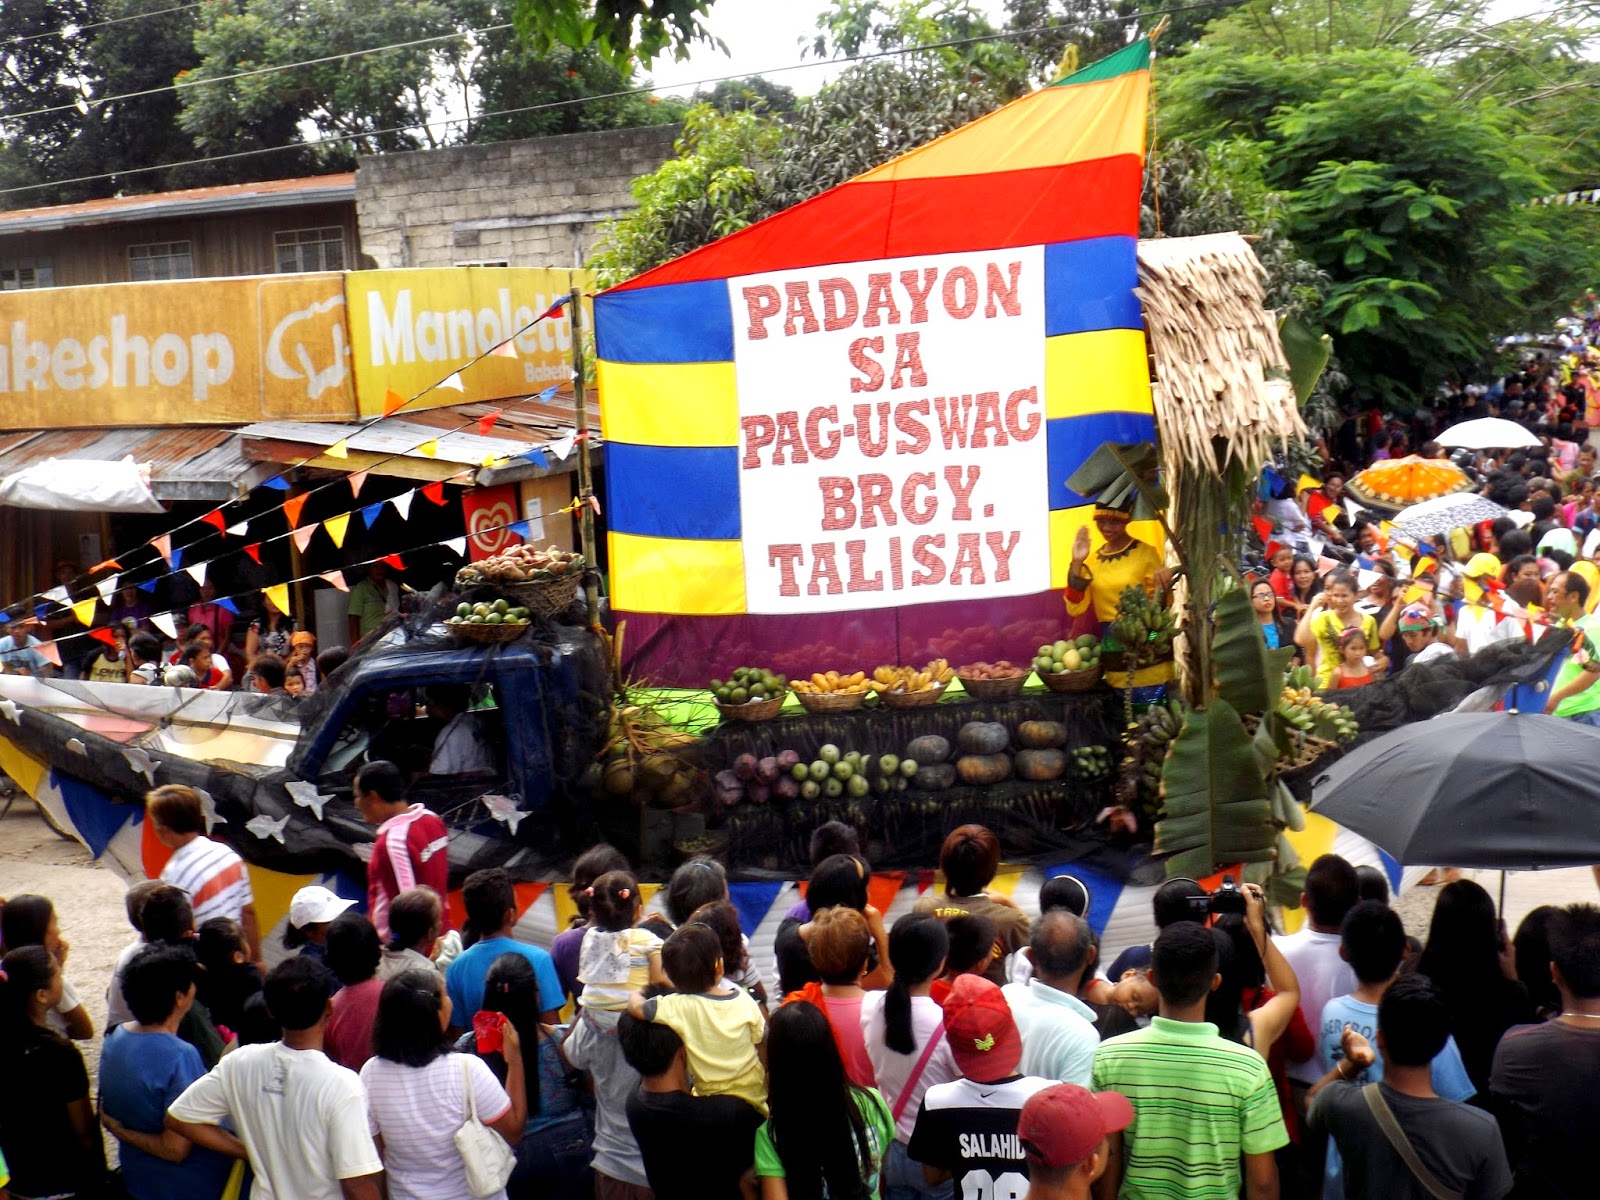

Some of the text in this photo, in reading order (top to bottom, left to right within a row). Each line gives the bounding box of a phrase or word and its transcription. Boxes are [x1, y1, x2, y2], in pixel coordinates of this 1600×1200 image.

[366, 287, 590, 367] Manolett
[742, 261, 1022, 340] PADAYON
[0, 313, 235, 401] keshop
[848, 331, 928, 393] SA
[741, 386, 1042, 470] PAG-USWAG
[818, 465, 995, 531] BRGY.
[768, 531, 1021, 597] TALISAY
